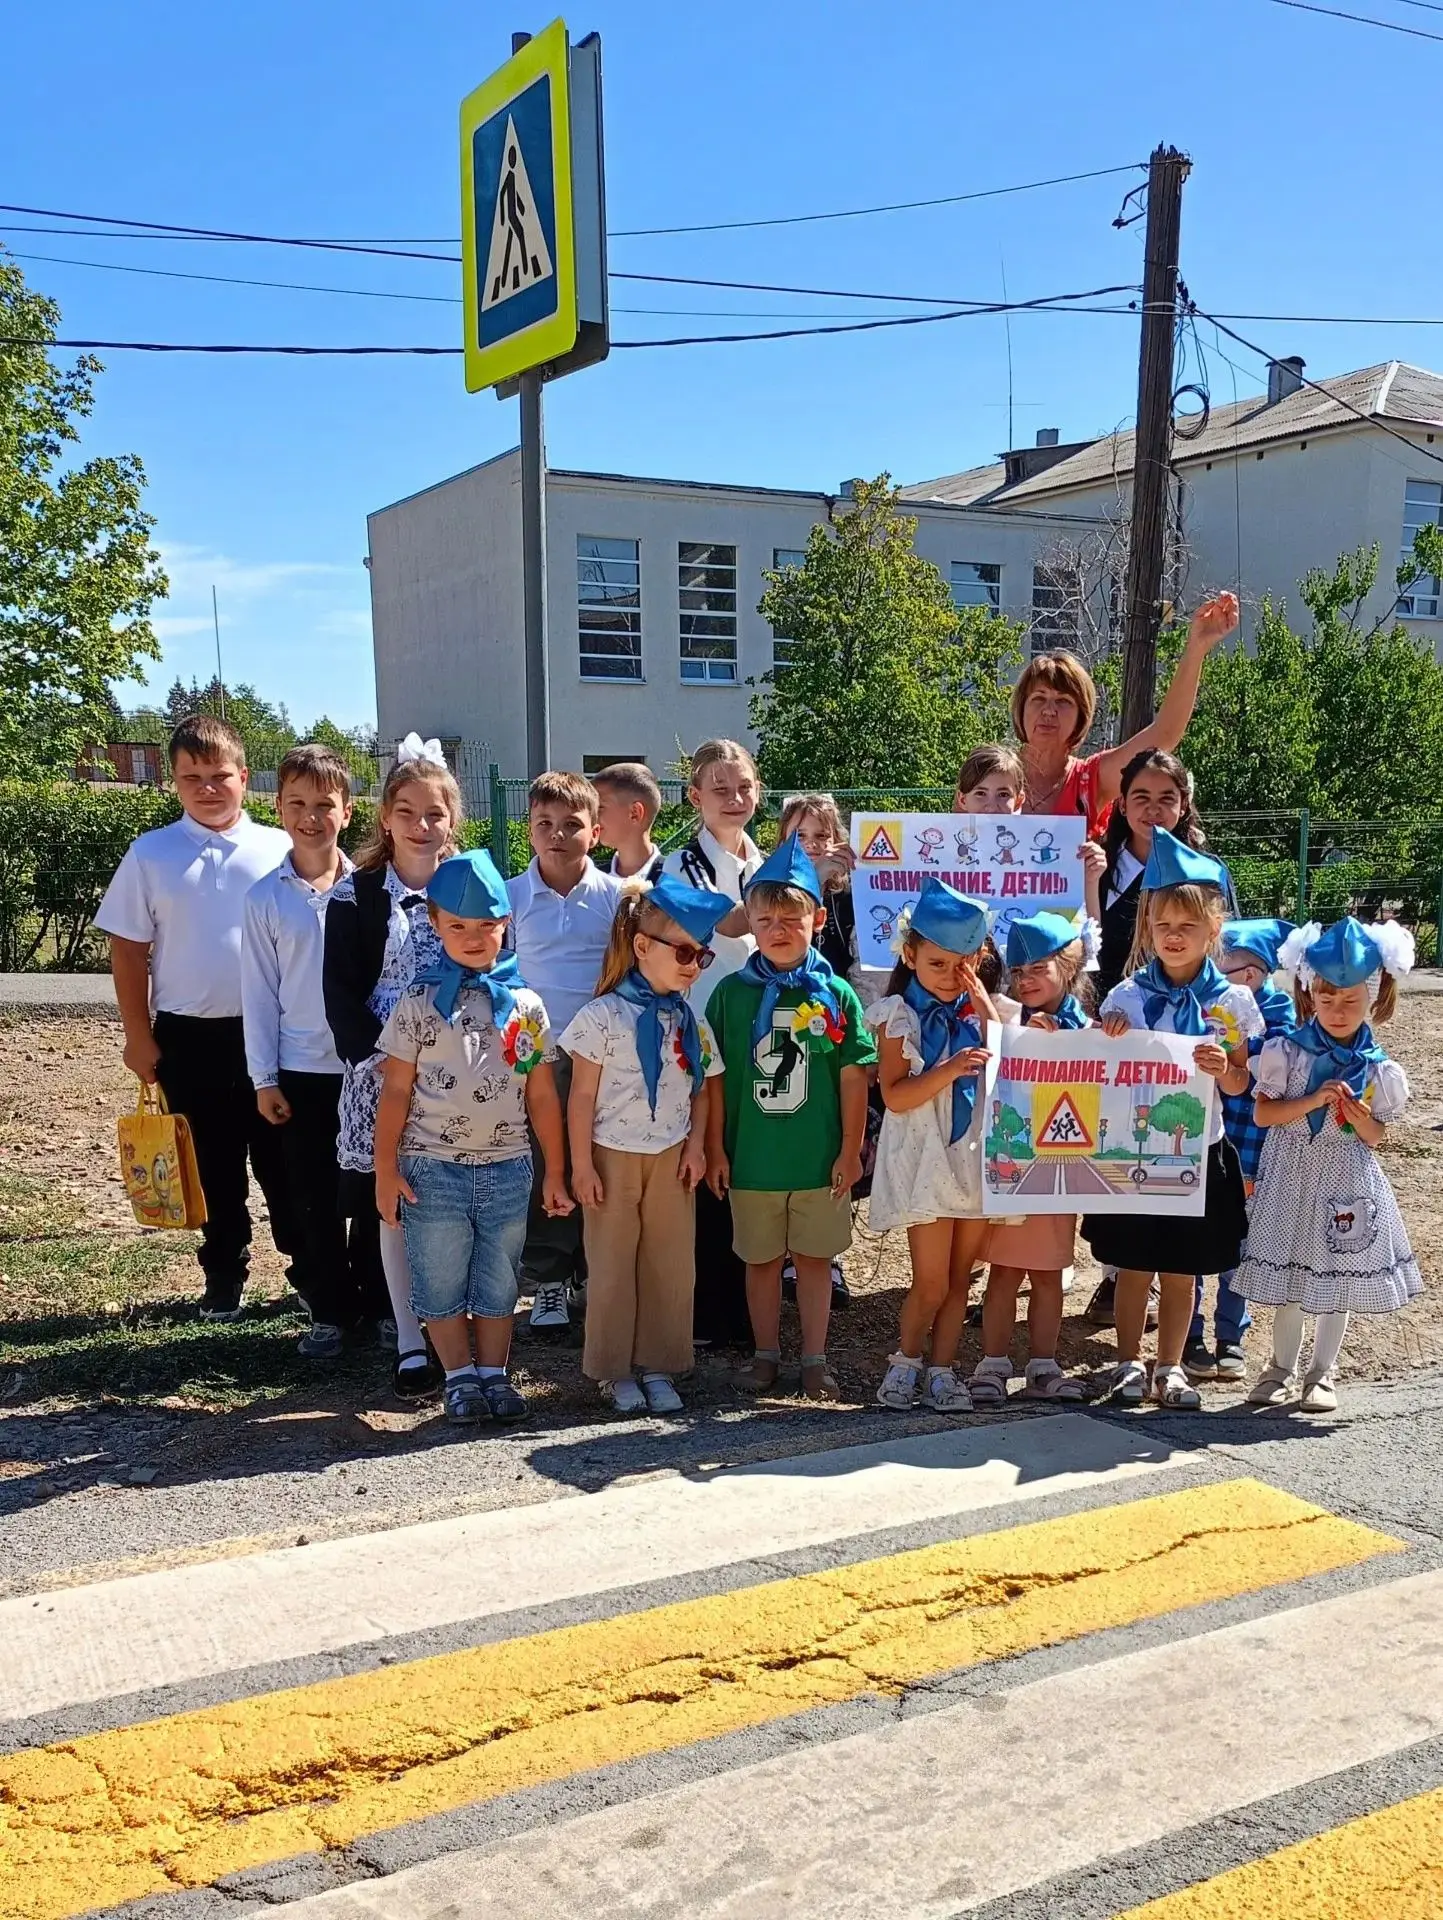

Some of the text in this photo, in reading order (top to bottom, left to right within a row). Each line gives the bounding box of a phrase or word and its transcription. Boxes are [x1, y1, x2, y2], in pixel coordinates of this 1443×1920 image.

[869, 870, 1068, 898] «ВНИАНИЕ, ДЕТИ!»
[1000, 1057, 1188, 1087] ВНИМАНИЕ, ДЕТИ!»
